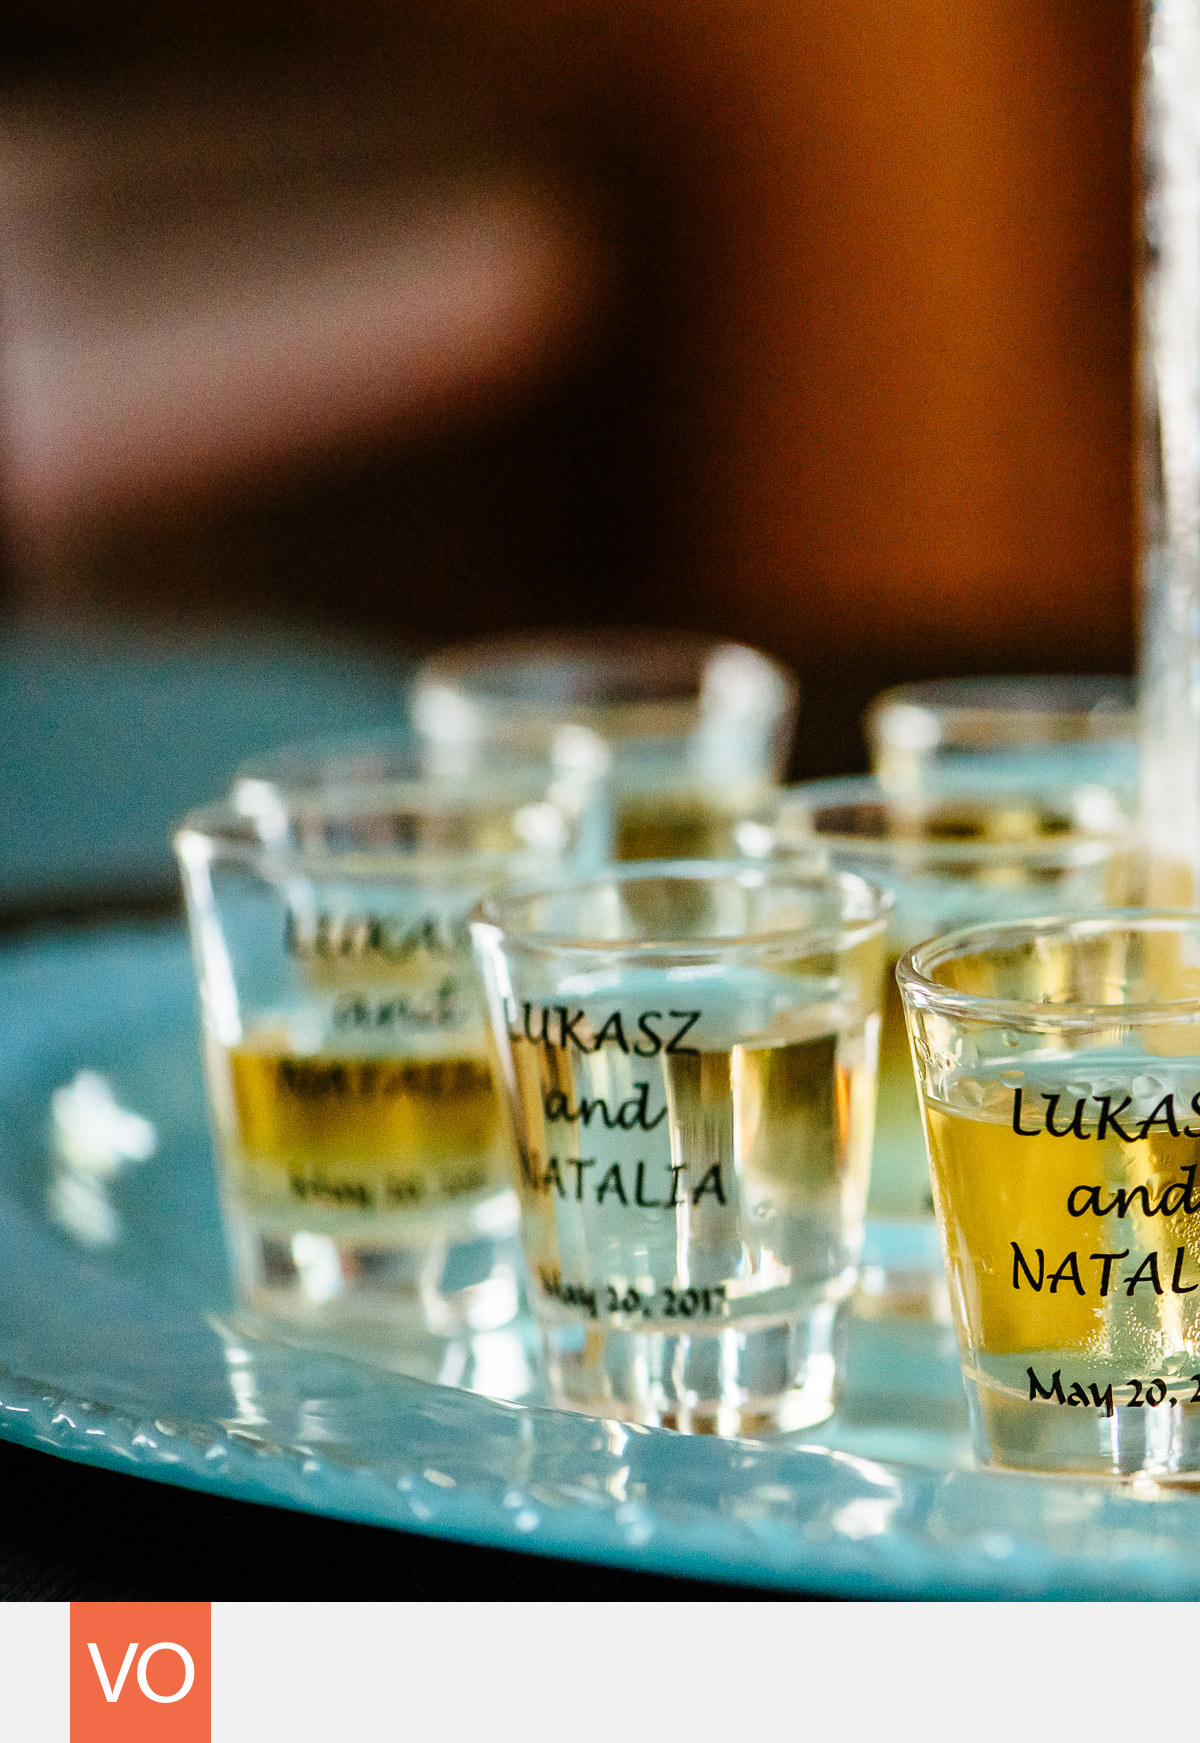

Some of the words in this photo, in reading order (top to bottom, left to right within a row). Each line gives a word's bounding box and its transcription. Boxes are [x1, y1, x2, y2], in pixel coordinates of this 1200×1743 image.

[544, 1082, 669, 1132] and
[607, 1285, 652, 1320] 20,
[662, 1285, 727, 1318] 2017
[1027, 1366, 1114, 1418] May
[1126, 1378, 1178, 1409] 20,
